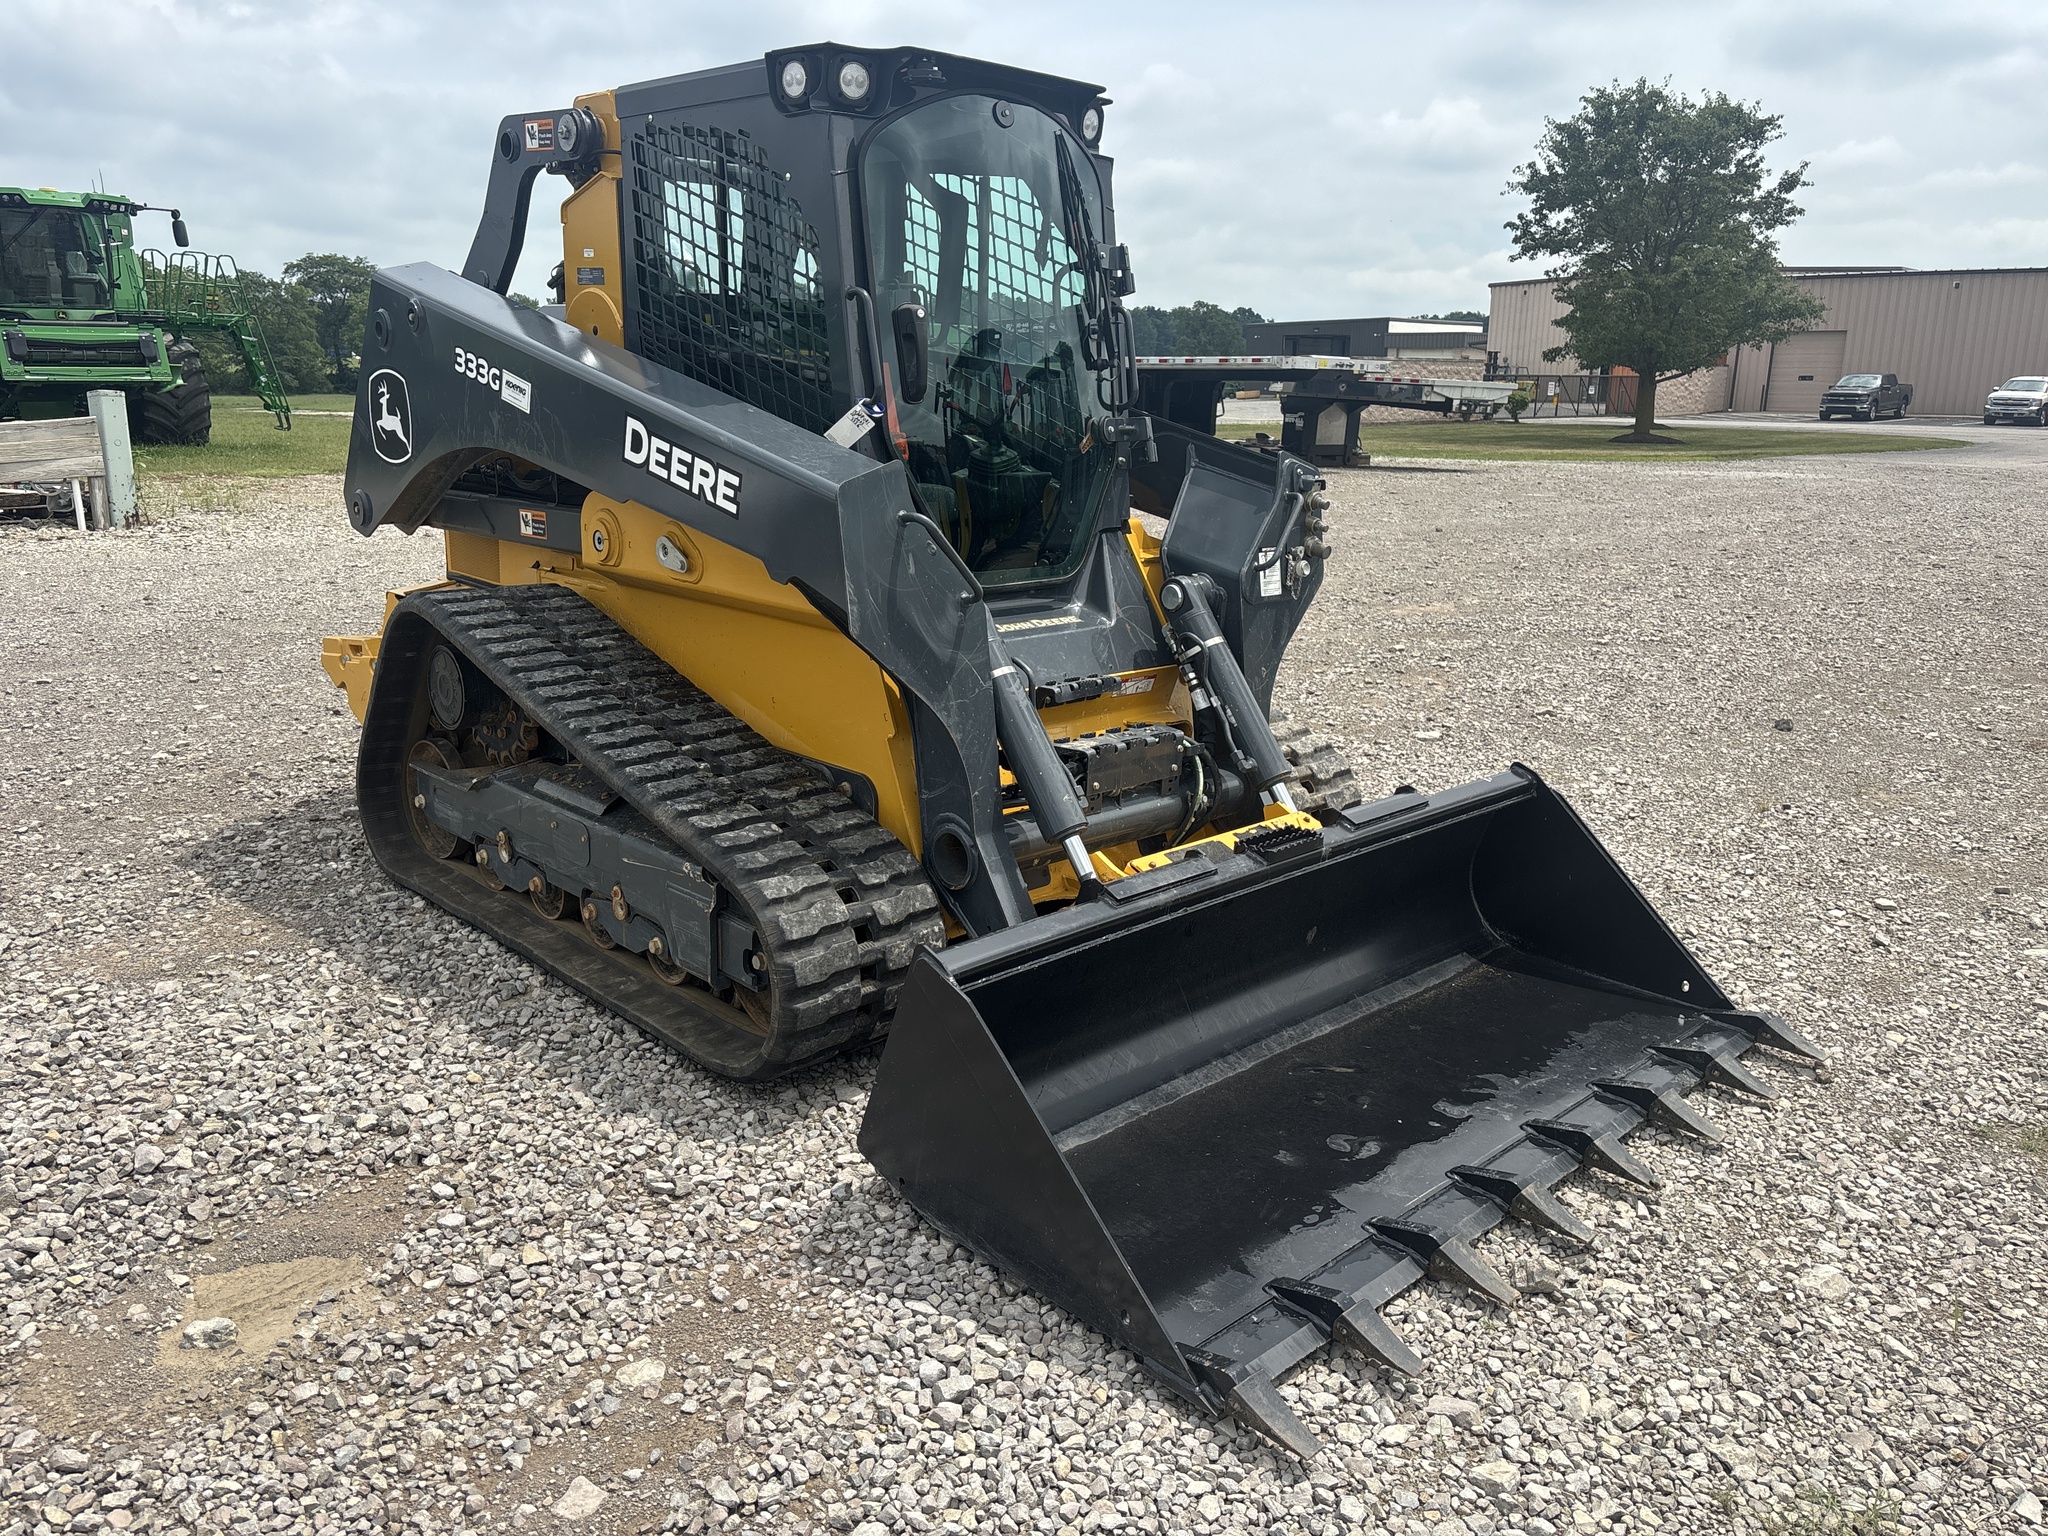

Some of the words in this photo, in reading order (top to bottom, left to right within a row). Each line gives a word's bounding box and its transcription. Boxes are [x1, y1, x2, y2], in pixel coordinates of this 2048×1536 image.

[454, 347, 500, 391] 333G
[624, 416, 740, 514] DEERE
[995, 620, 1034, 633] JOHN
[1030, 615, 1083, 628] DEERE
